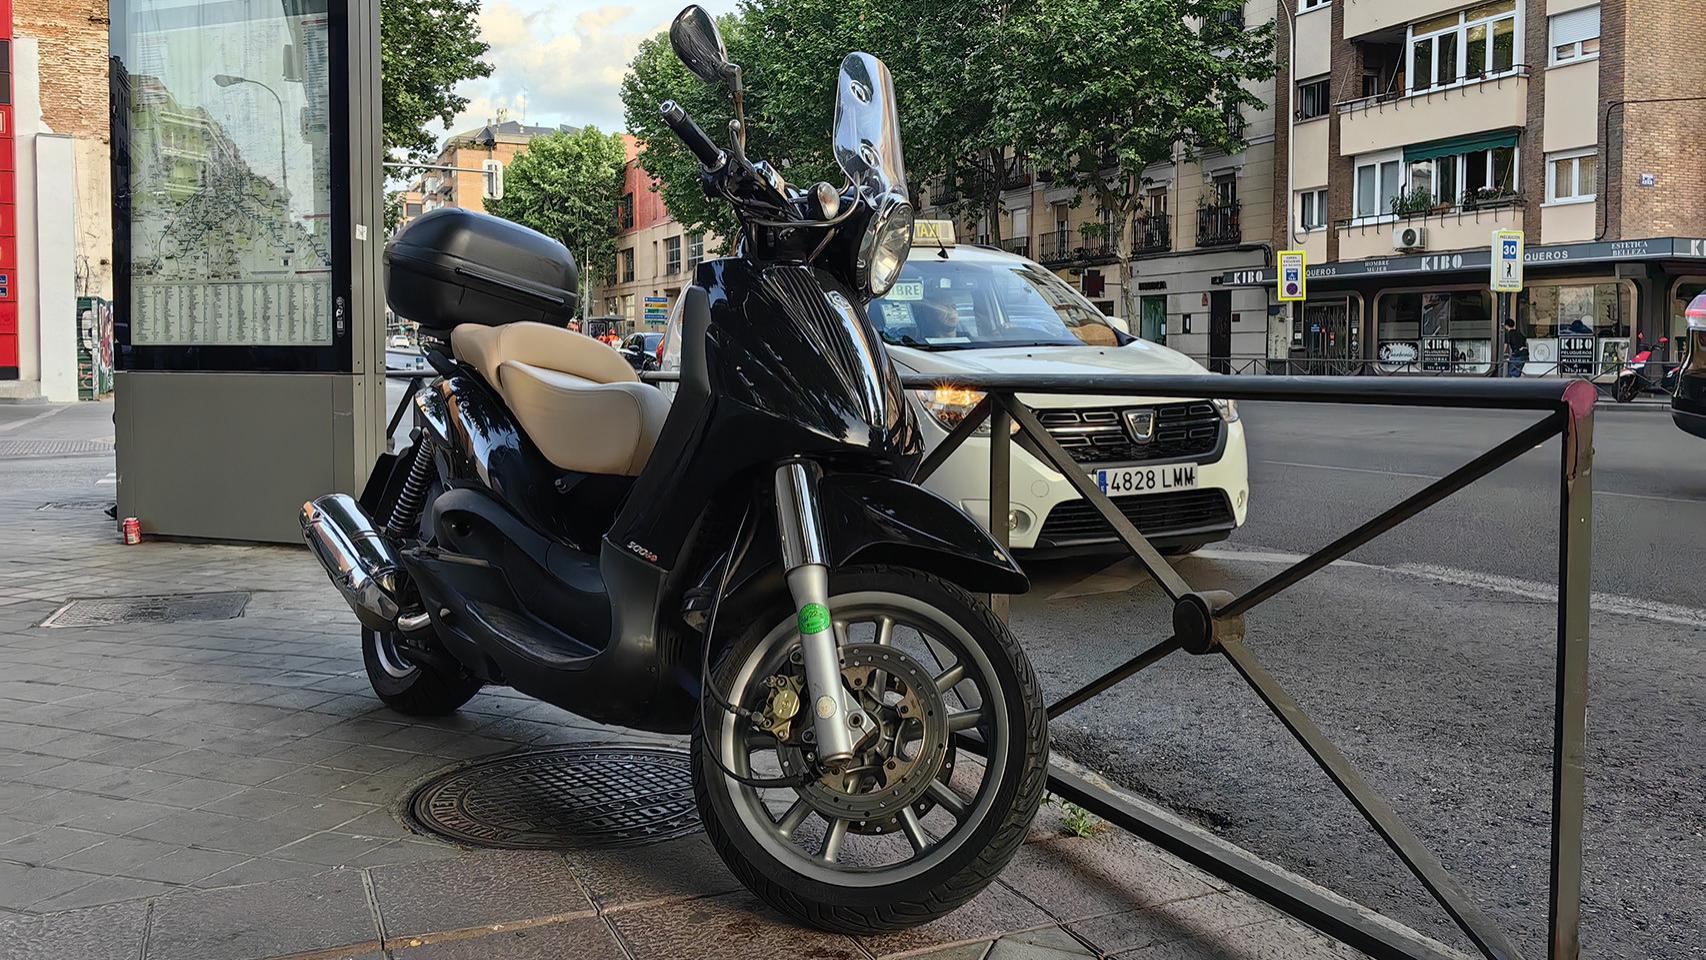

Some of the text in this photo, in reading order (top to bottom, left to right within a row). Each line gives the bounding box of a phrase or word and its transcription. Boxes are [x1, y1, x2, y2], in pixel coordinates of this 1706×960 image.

[914, 222, 938, 238] TAXI
[1503, 245, 1516, 255] 30
[1524, 251, 1569, 261] QUEROS
[1421, 254, 1463, 271] KIBO
[1233, 270, 1263, 284] KIBO
[1306, 268, 1337, 277] QUEROS
[892, 284, 920, 296] IBRE
[1424, 339, 1450, 349] KIBO
[1561, 338, 1593, 350] KIBO
[1111, 466, 1194, 491] 4828 LMM
